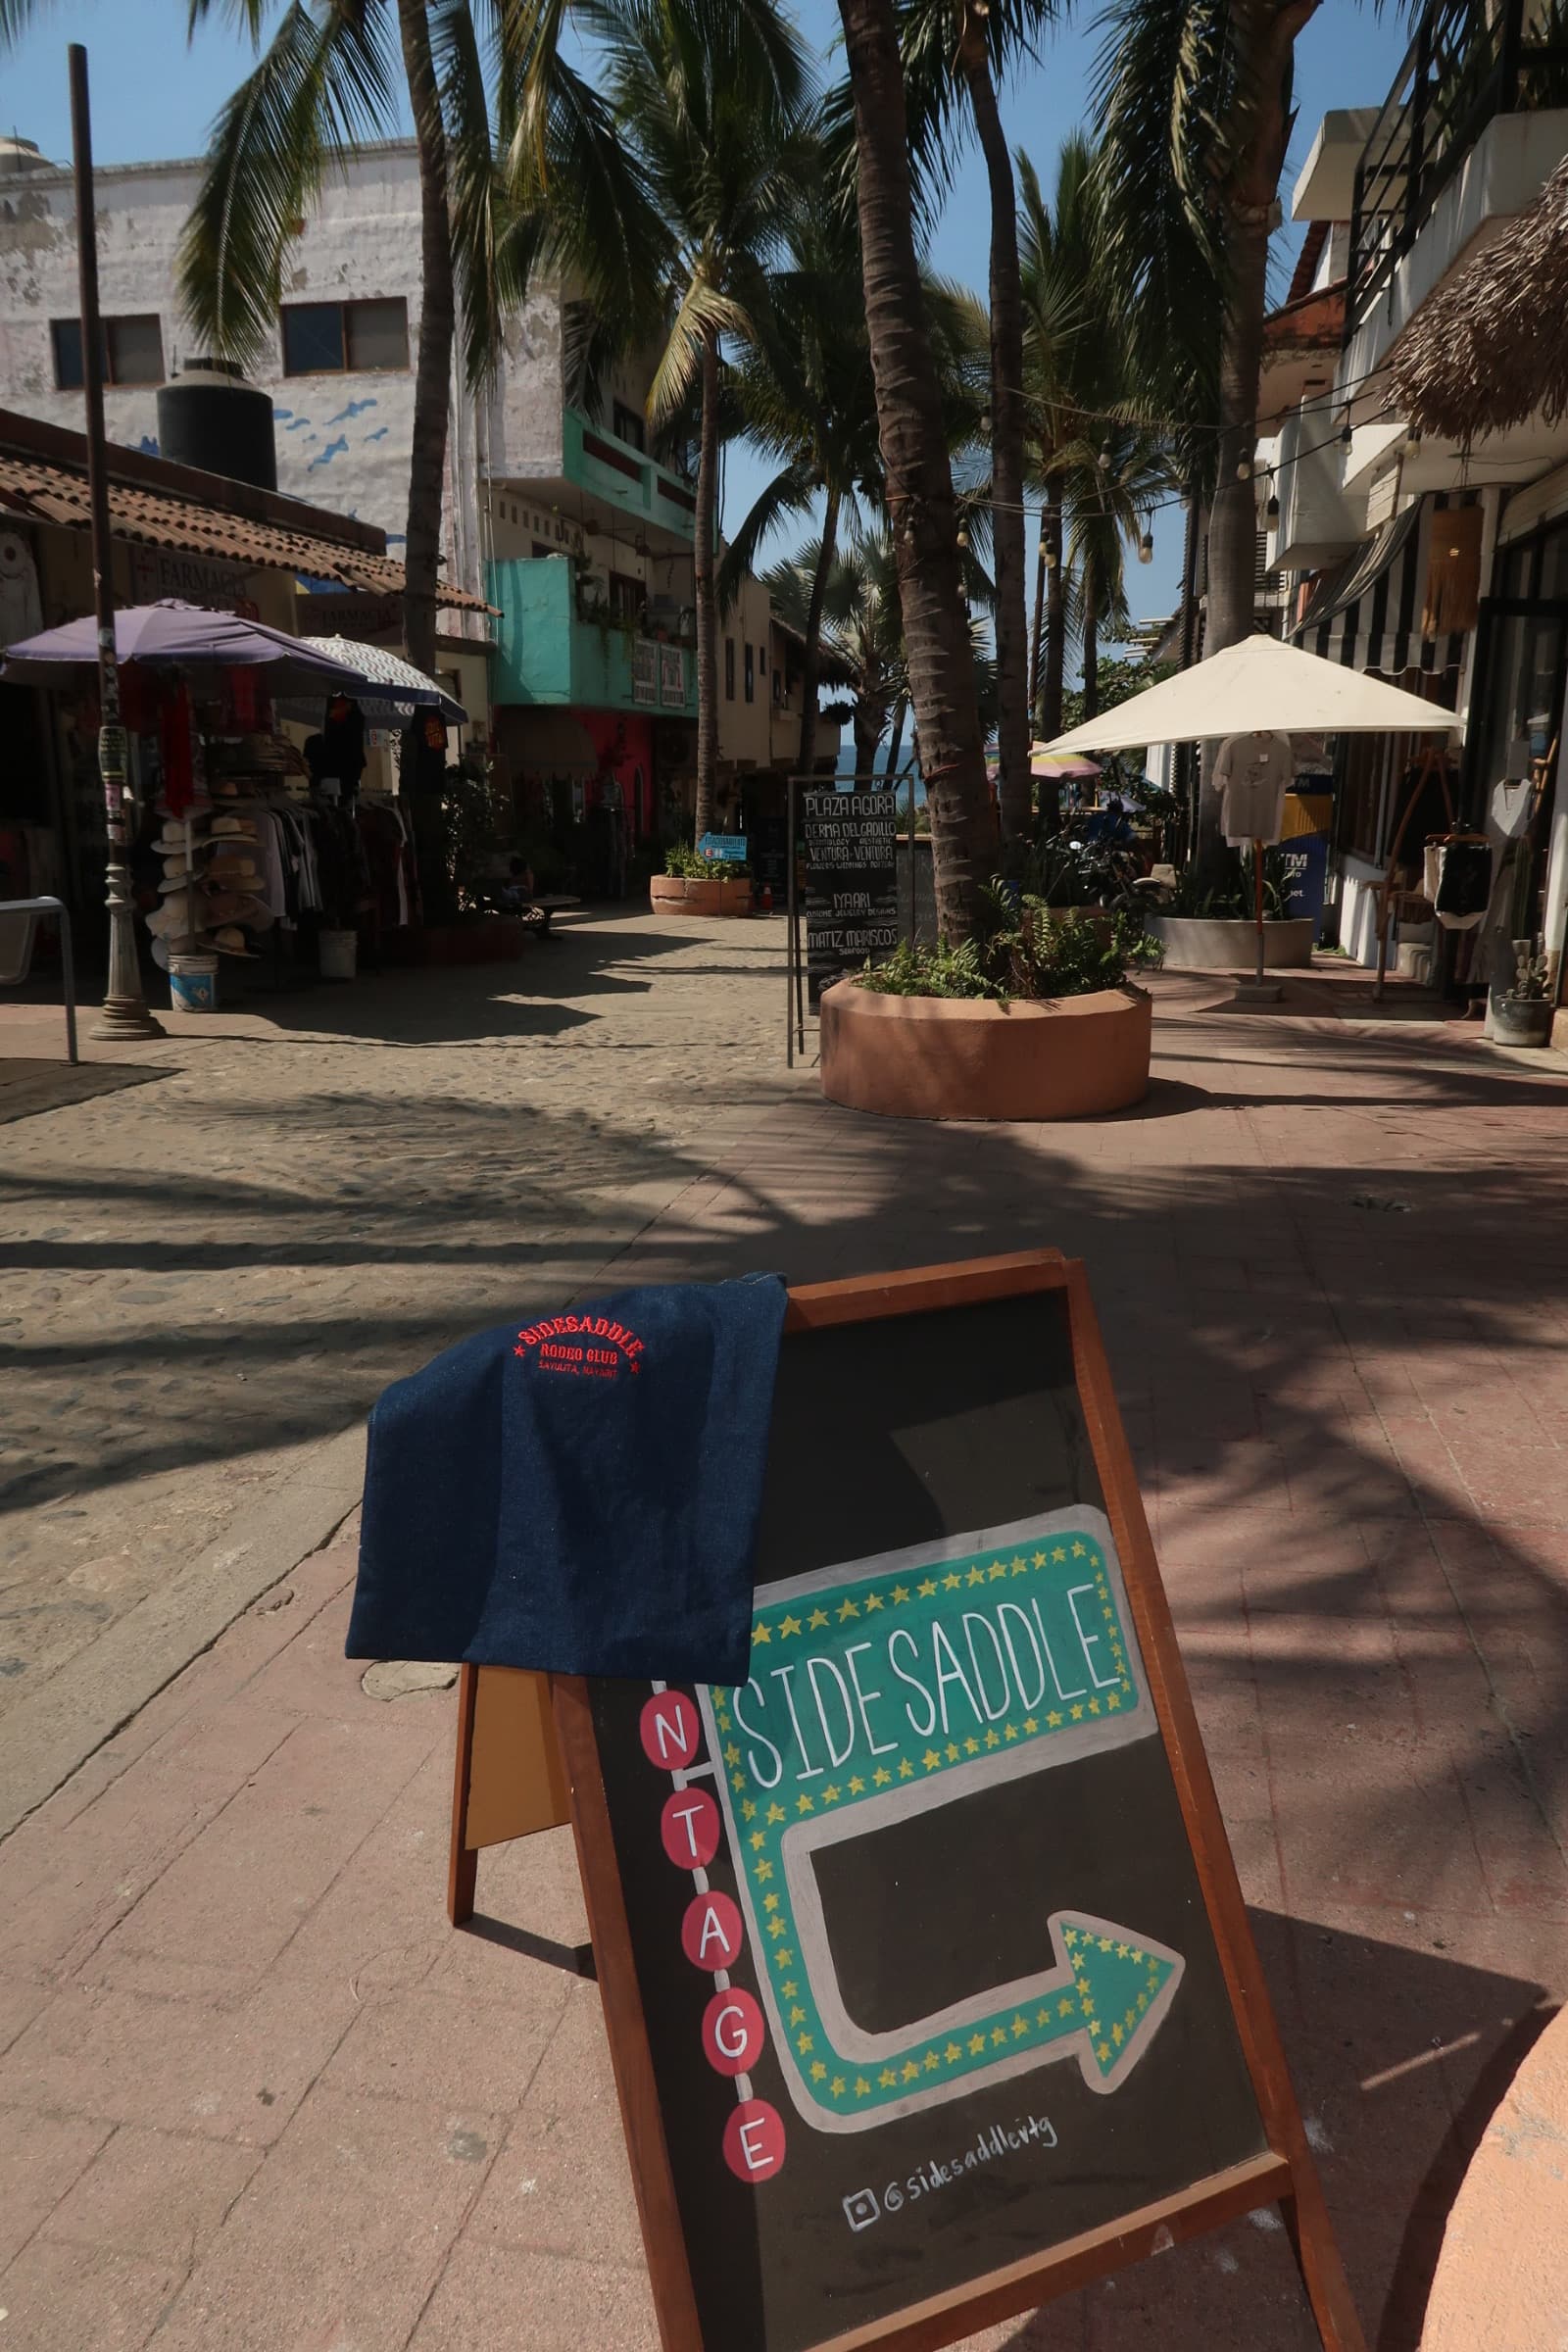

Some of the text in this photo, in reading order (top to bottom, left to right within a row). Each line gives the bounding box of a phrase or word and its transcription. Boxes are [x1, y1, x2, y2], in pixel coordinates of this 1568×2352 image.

[806, 795, 895, 816] PLAZA AGORA
[805, 821, 896, 839] DERMA DELGADILLO
[833, 893, 870, 909] IYAARI
[808, 928, 898, 950] MATIZ MARISCOS
[517, 1314, 645, 1359] SIDESADDLE
[540, 1343, 618, 1365] RODEO CLUB
[732, 1583, 1121, 1788] SIDESADDLE
[653, 1703, 775, 2171] NTAGE
